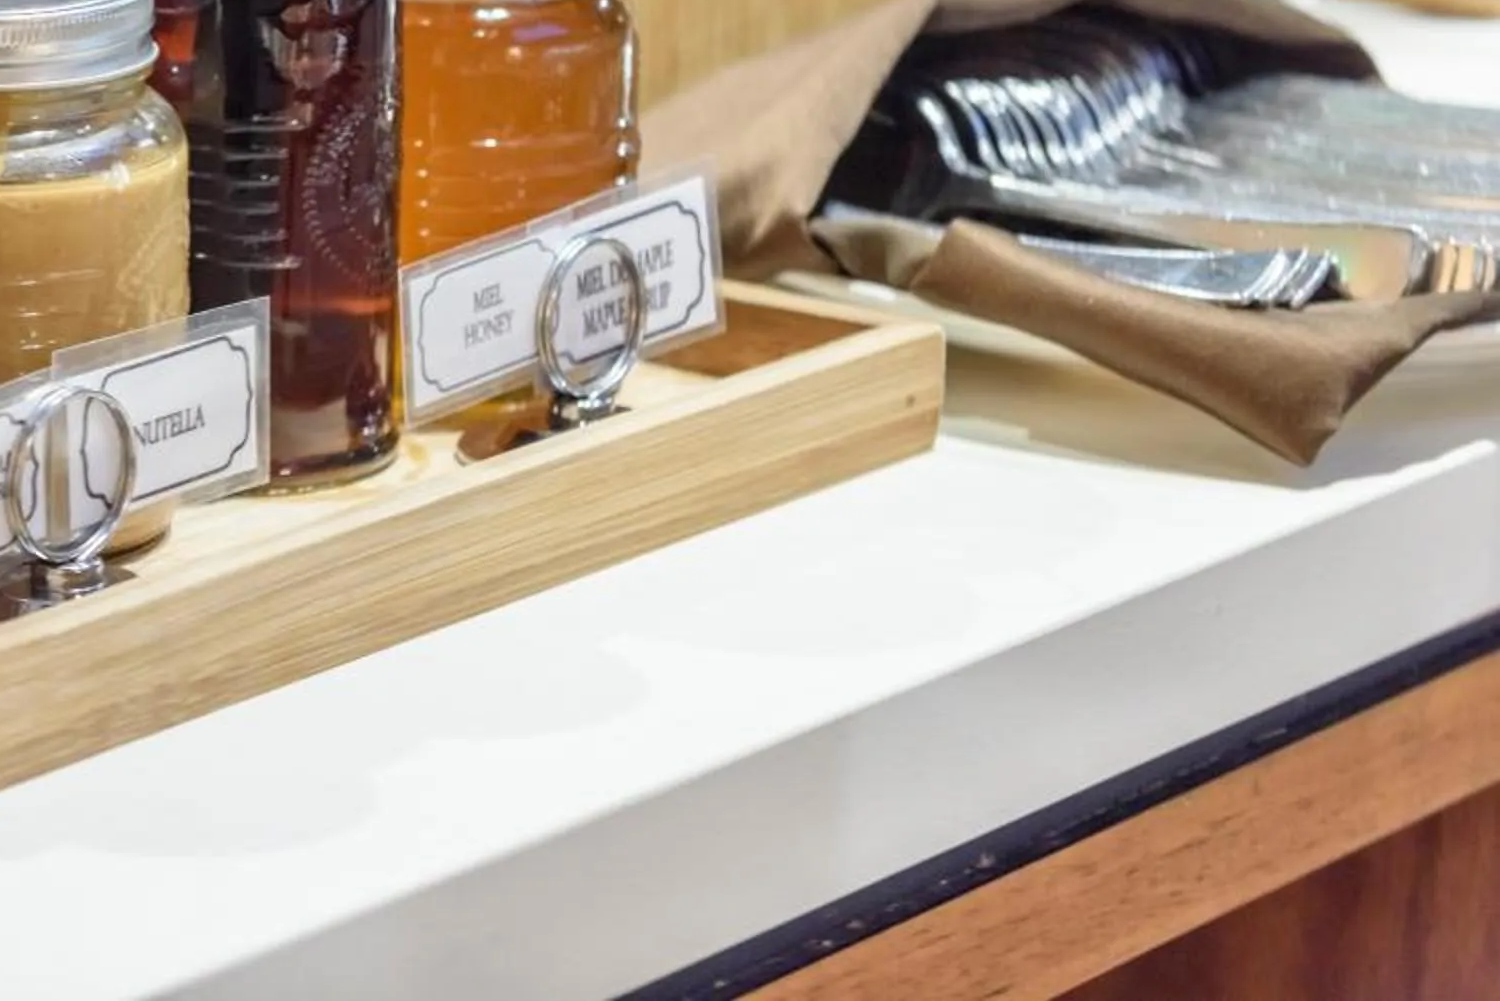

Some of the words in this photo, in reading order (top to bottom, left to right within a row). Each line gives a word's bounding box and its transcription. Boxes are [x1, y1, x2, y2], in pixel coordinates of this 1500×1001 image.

[575, 264, 606, 301] MIEL
[464, 309, 514, 348] HONEY
[132, 402, 206, 448] NUTELLA
